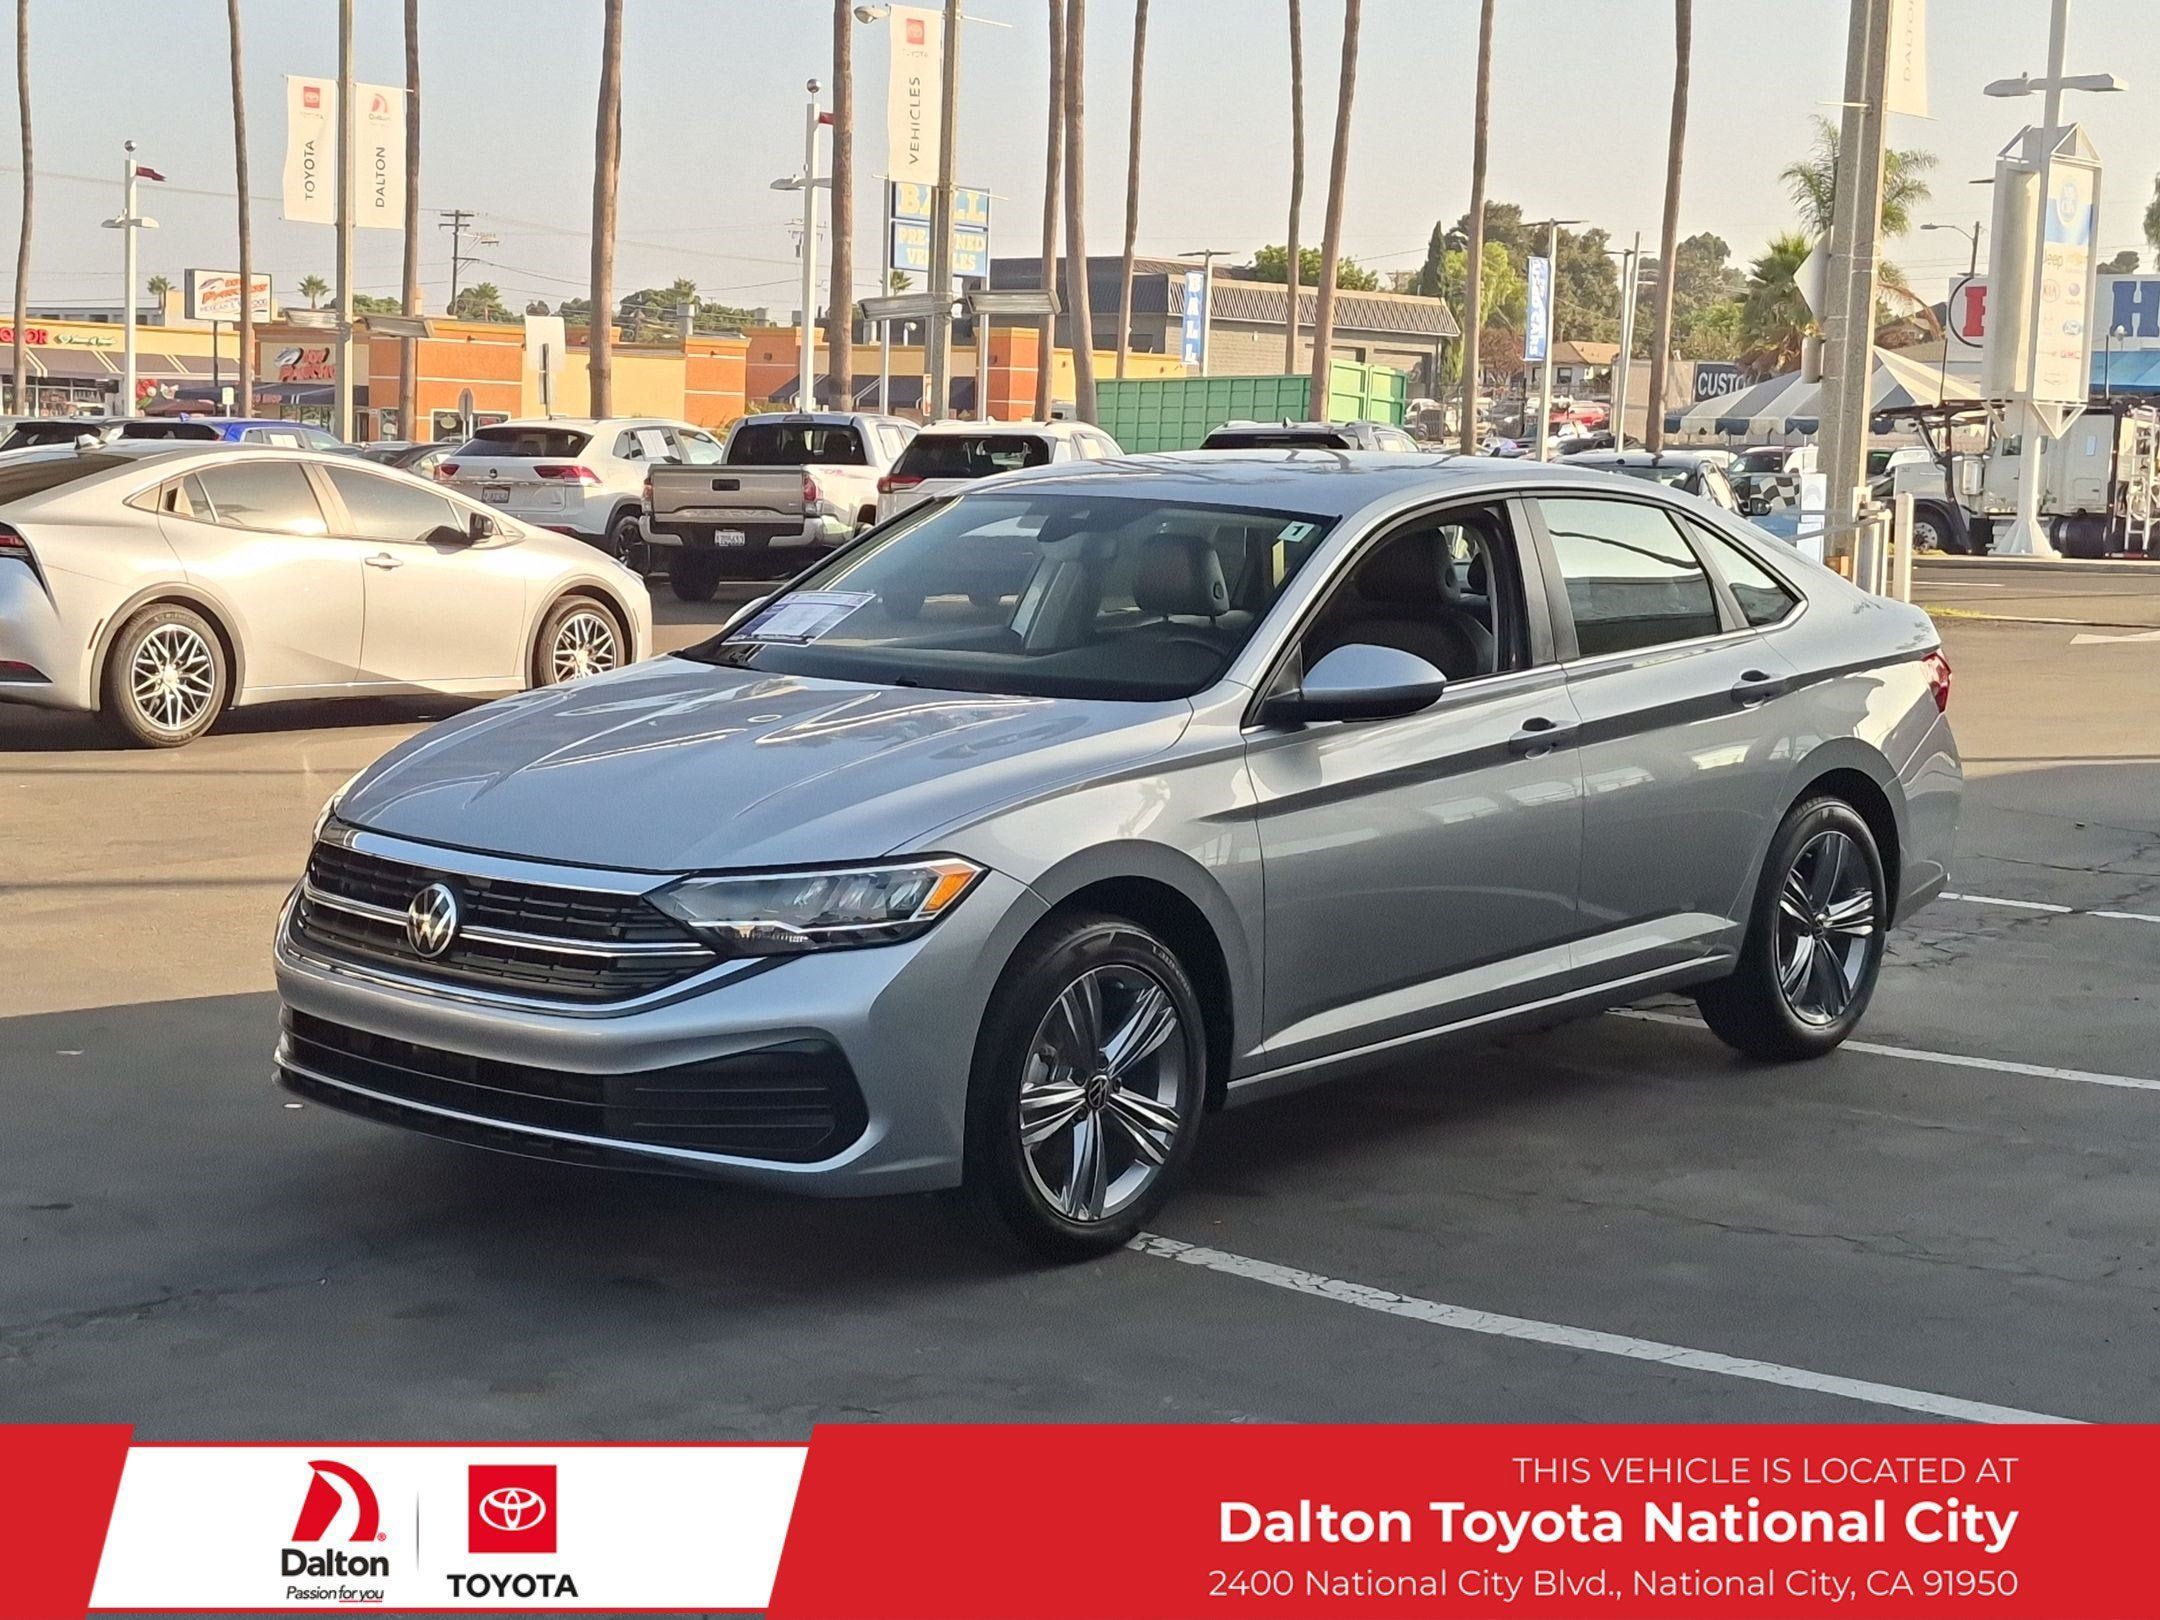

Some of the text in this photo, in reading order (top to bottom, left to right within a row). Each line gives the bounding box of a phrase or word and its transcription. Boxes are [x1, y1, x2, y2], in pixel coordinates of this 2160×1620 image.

[908, 76, 921, 165] VEHICLES
[303, 139, 316, 201] TOYOTA
[375, 146, 386, 208] DALTON
[906, 247, 976, 271] VELES
[0, 326, 48, 345] QOR
[1184, 272, 1201, 361] BALL
[1697, 372, 1761, 396] CUSTO
